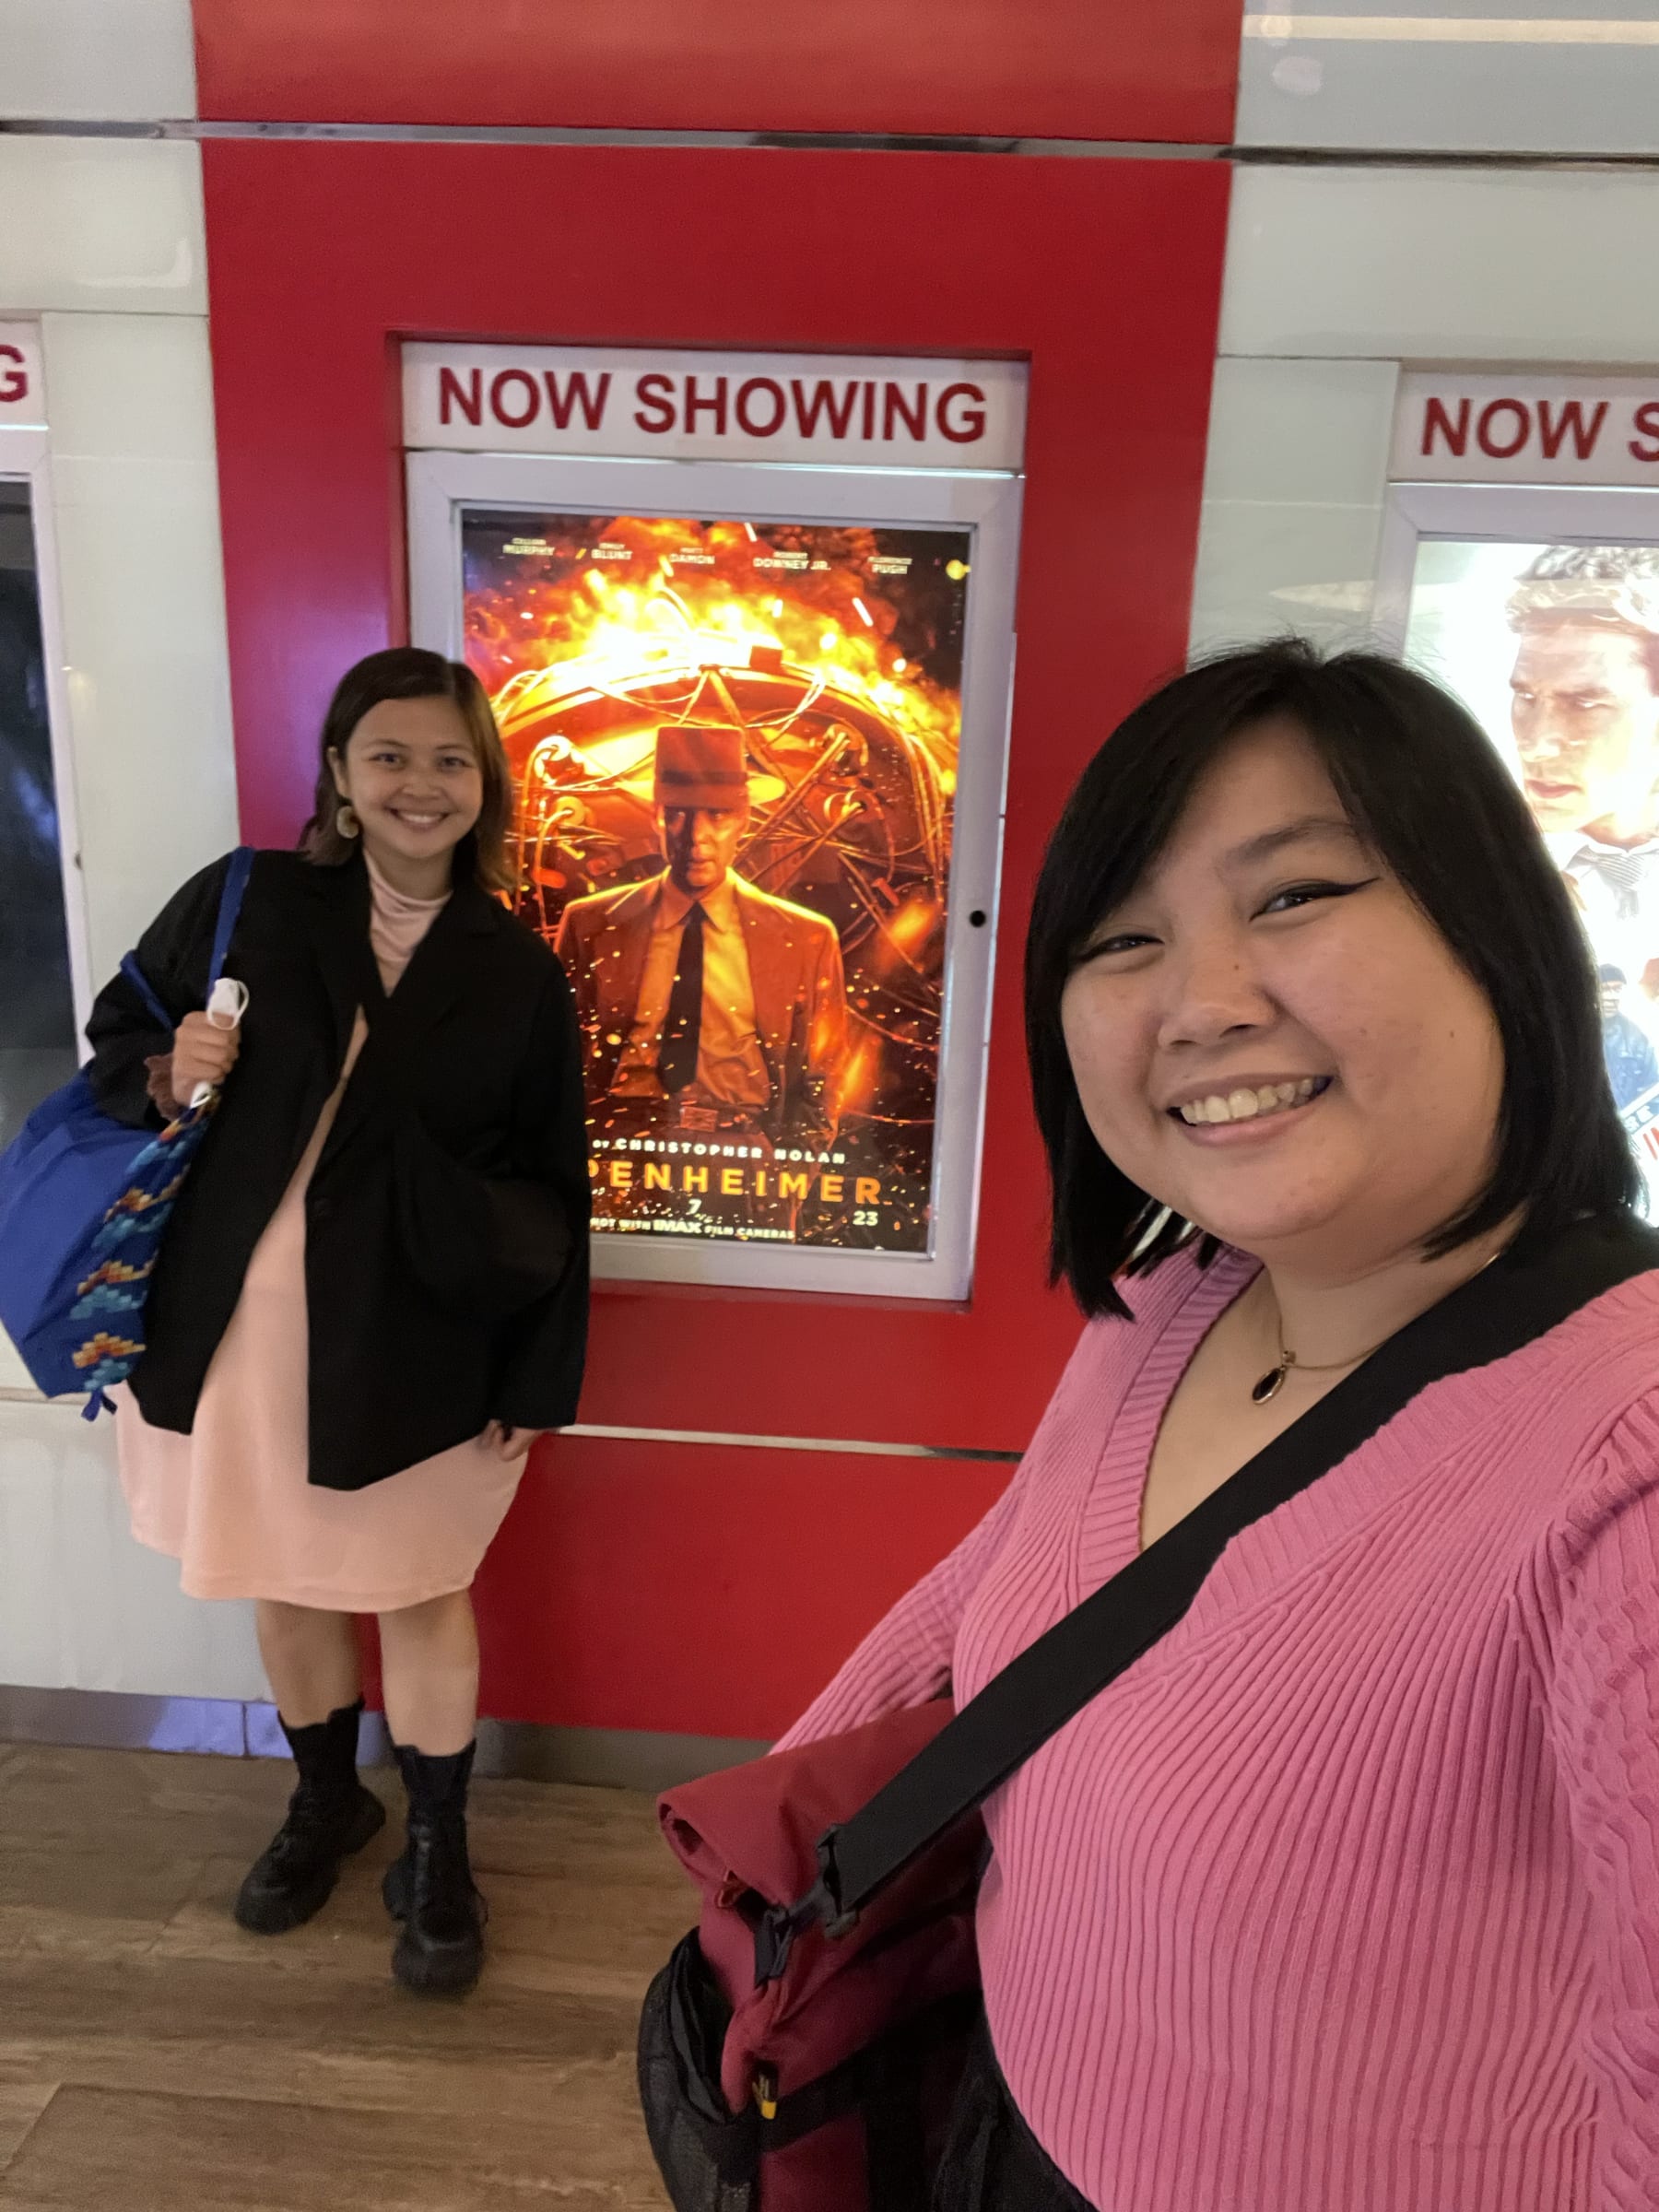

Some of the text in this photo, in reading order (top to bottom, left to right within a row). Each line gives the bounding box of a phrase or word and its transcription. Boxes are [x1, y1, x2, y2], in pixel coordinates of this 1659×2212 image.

[439, 366, 986, 444] NOW SHOWING
[1420, 397, 1611, 460] NOW
[591, 548, 633, 560] BLUNT
[669, 553, 715, 565] DAMON
[753, 557, 808, 570] DOWNEY
[615, 1137, 763, 1159] CHRISTOPHER
[773, 1148, 846, 1165] NOLAN
[687, 1198, 879, 1227] 7 23
[618, 1219, 651, 1230] WITH
[653, 1219, 703, 1234] IMAX
[704, 1225, 735, 1236] FILM
[737, 1228, 795, 1240] CAMERAS
